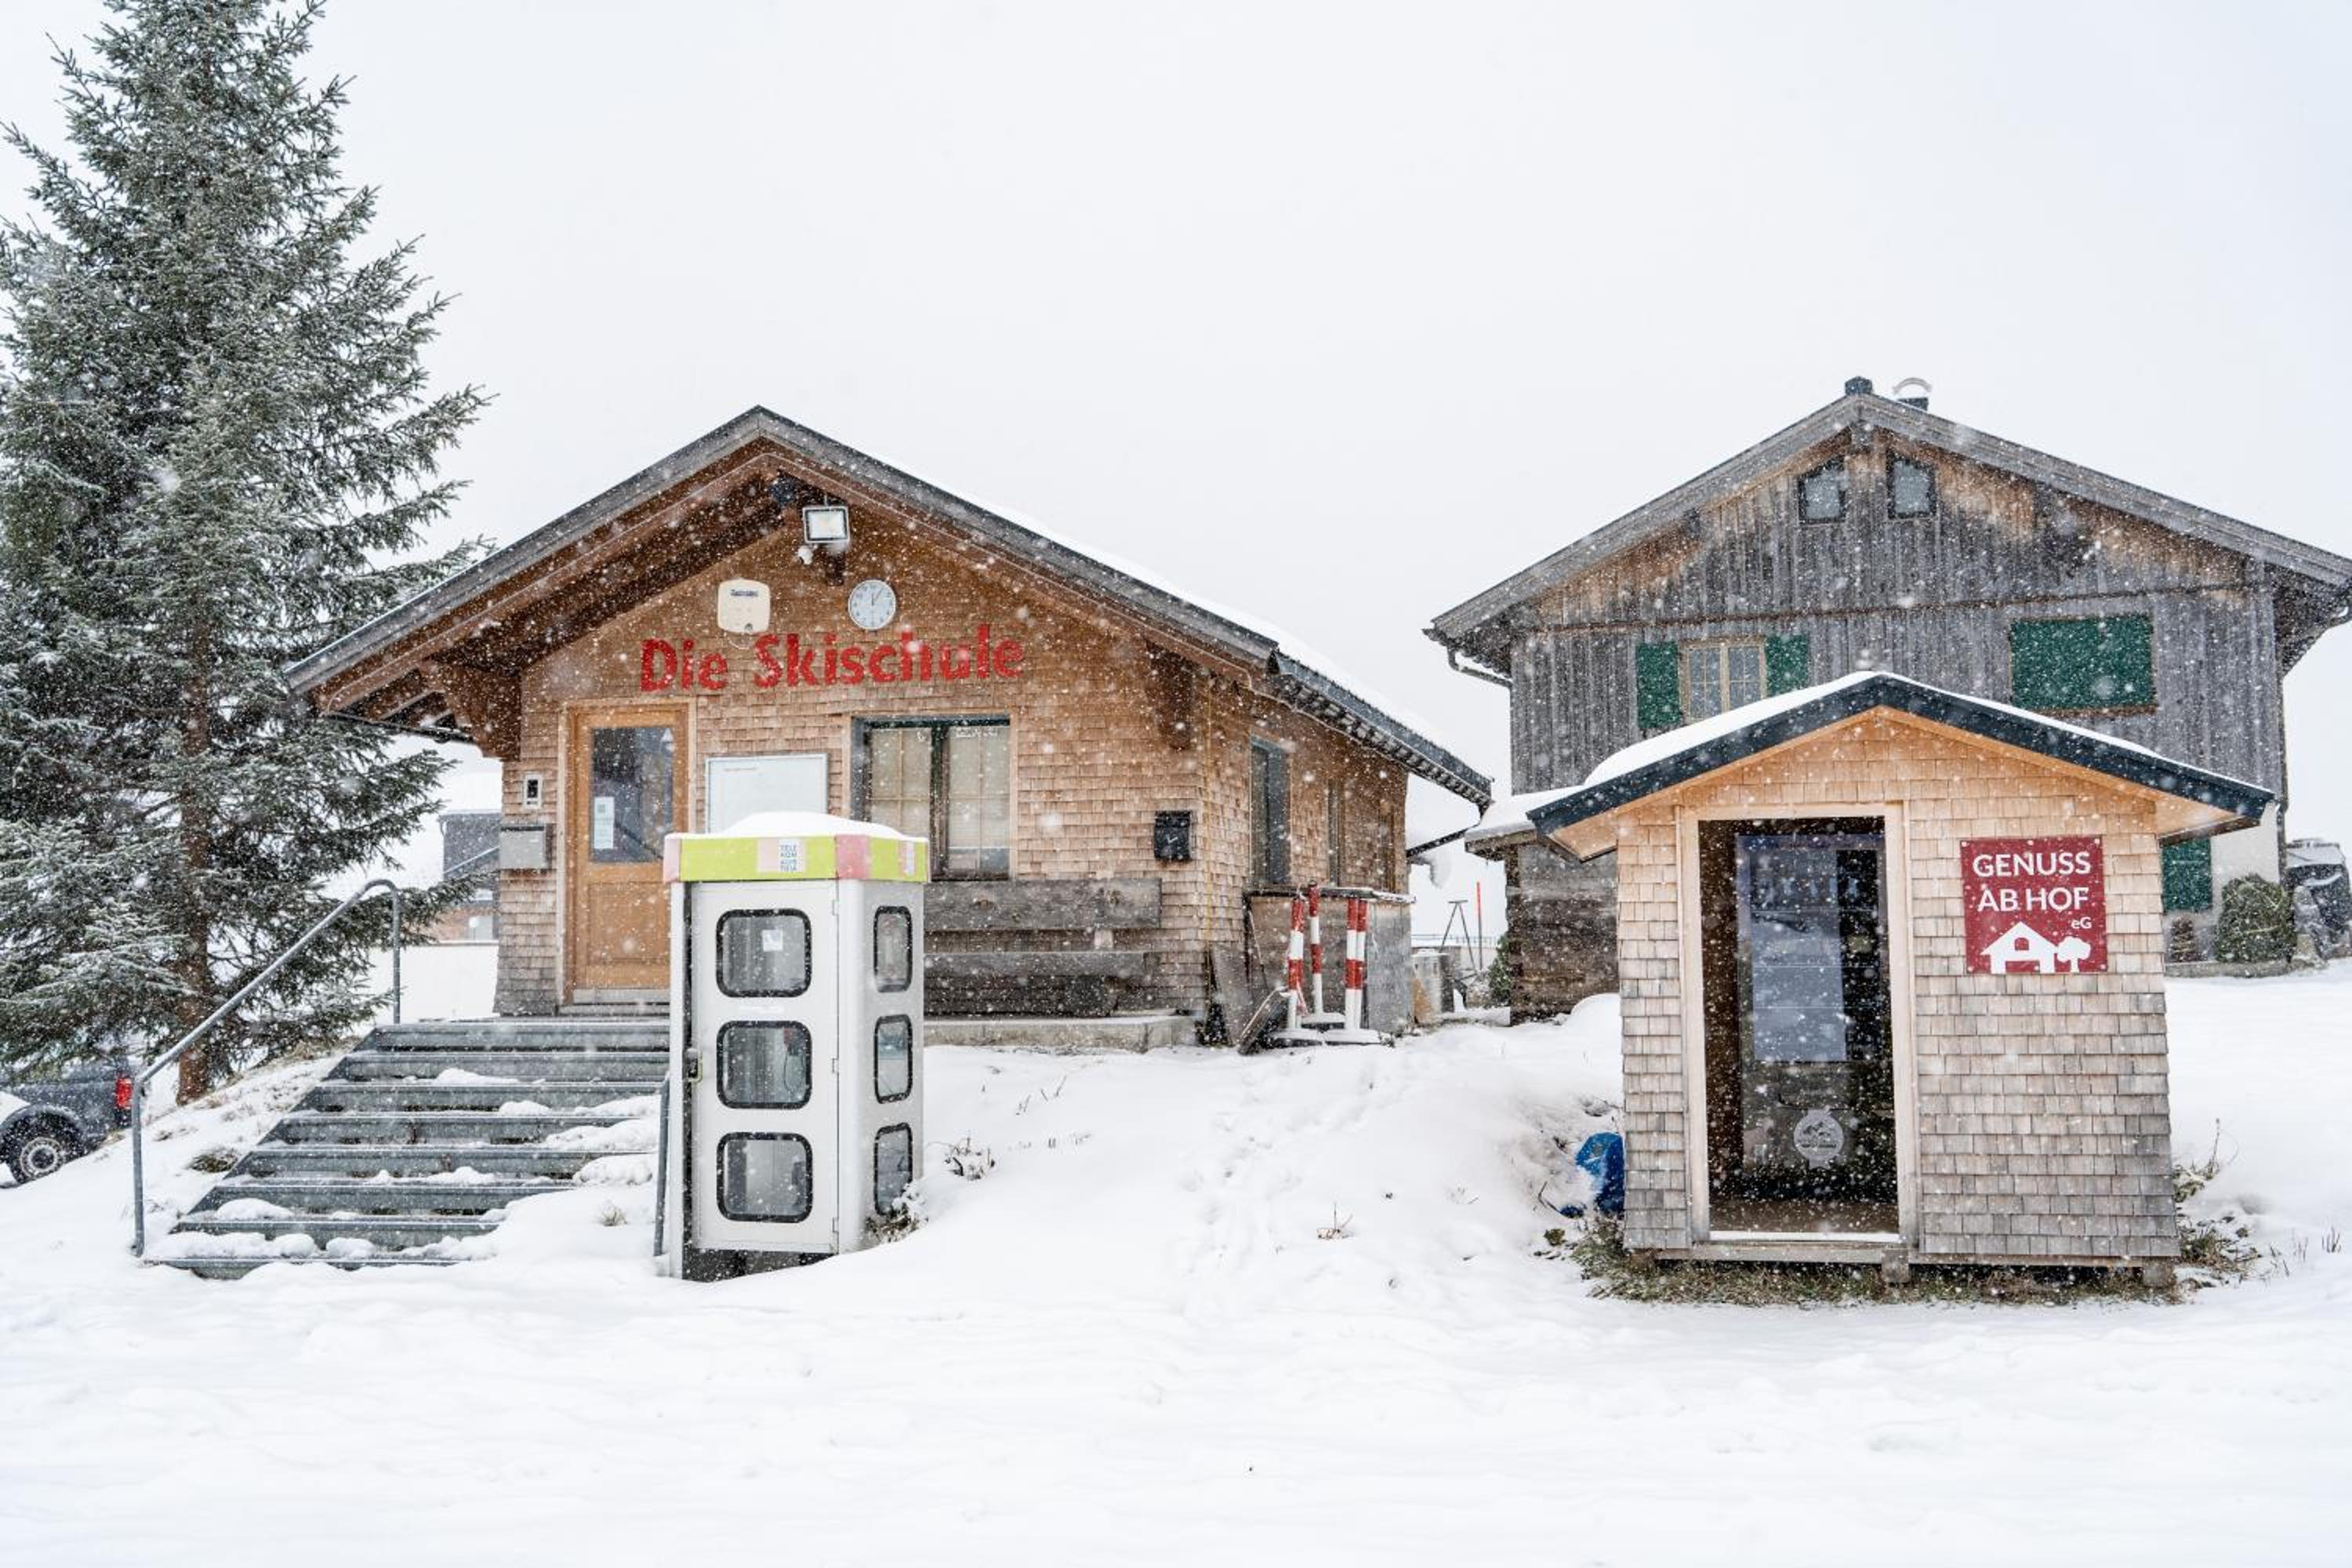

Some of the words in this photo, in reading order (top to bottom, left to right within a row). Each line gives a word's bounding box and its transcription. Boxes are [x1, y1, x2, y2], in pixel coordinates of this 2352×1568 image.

[641, 638, 728, 691] Die
[753, 624, 1024, 688] Skischule
[1973, 851, 2091, 877] GENUSS
[1977, 888, 2018, 912] AB
[2026, 887, 2089, 912] HOF
[2071, 916, 2092, 929] eG
